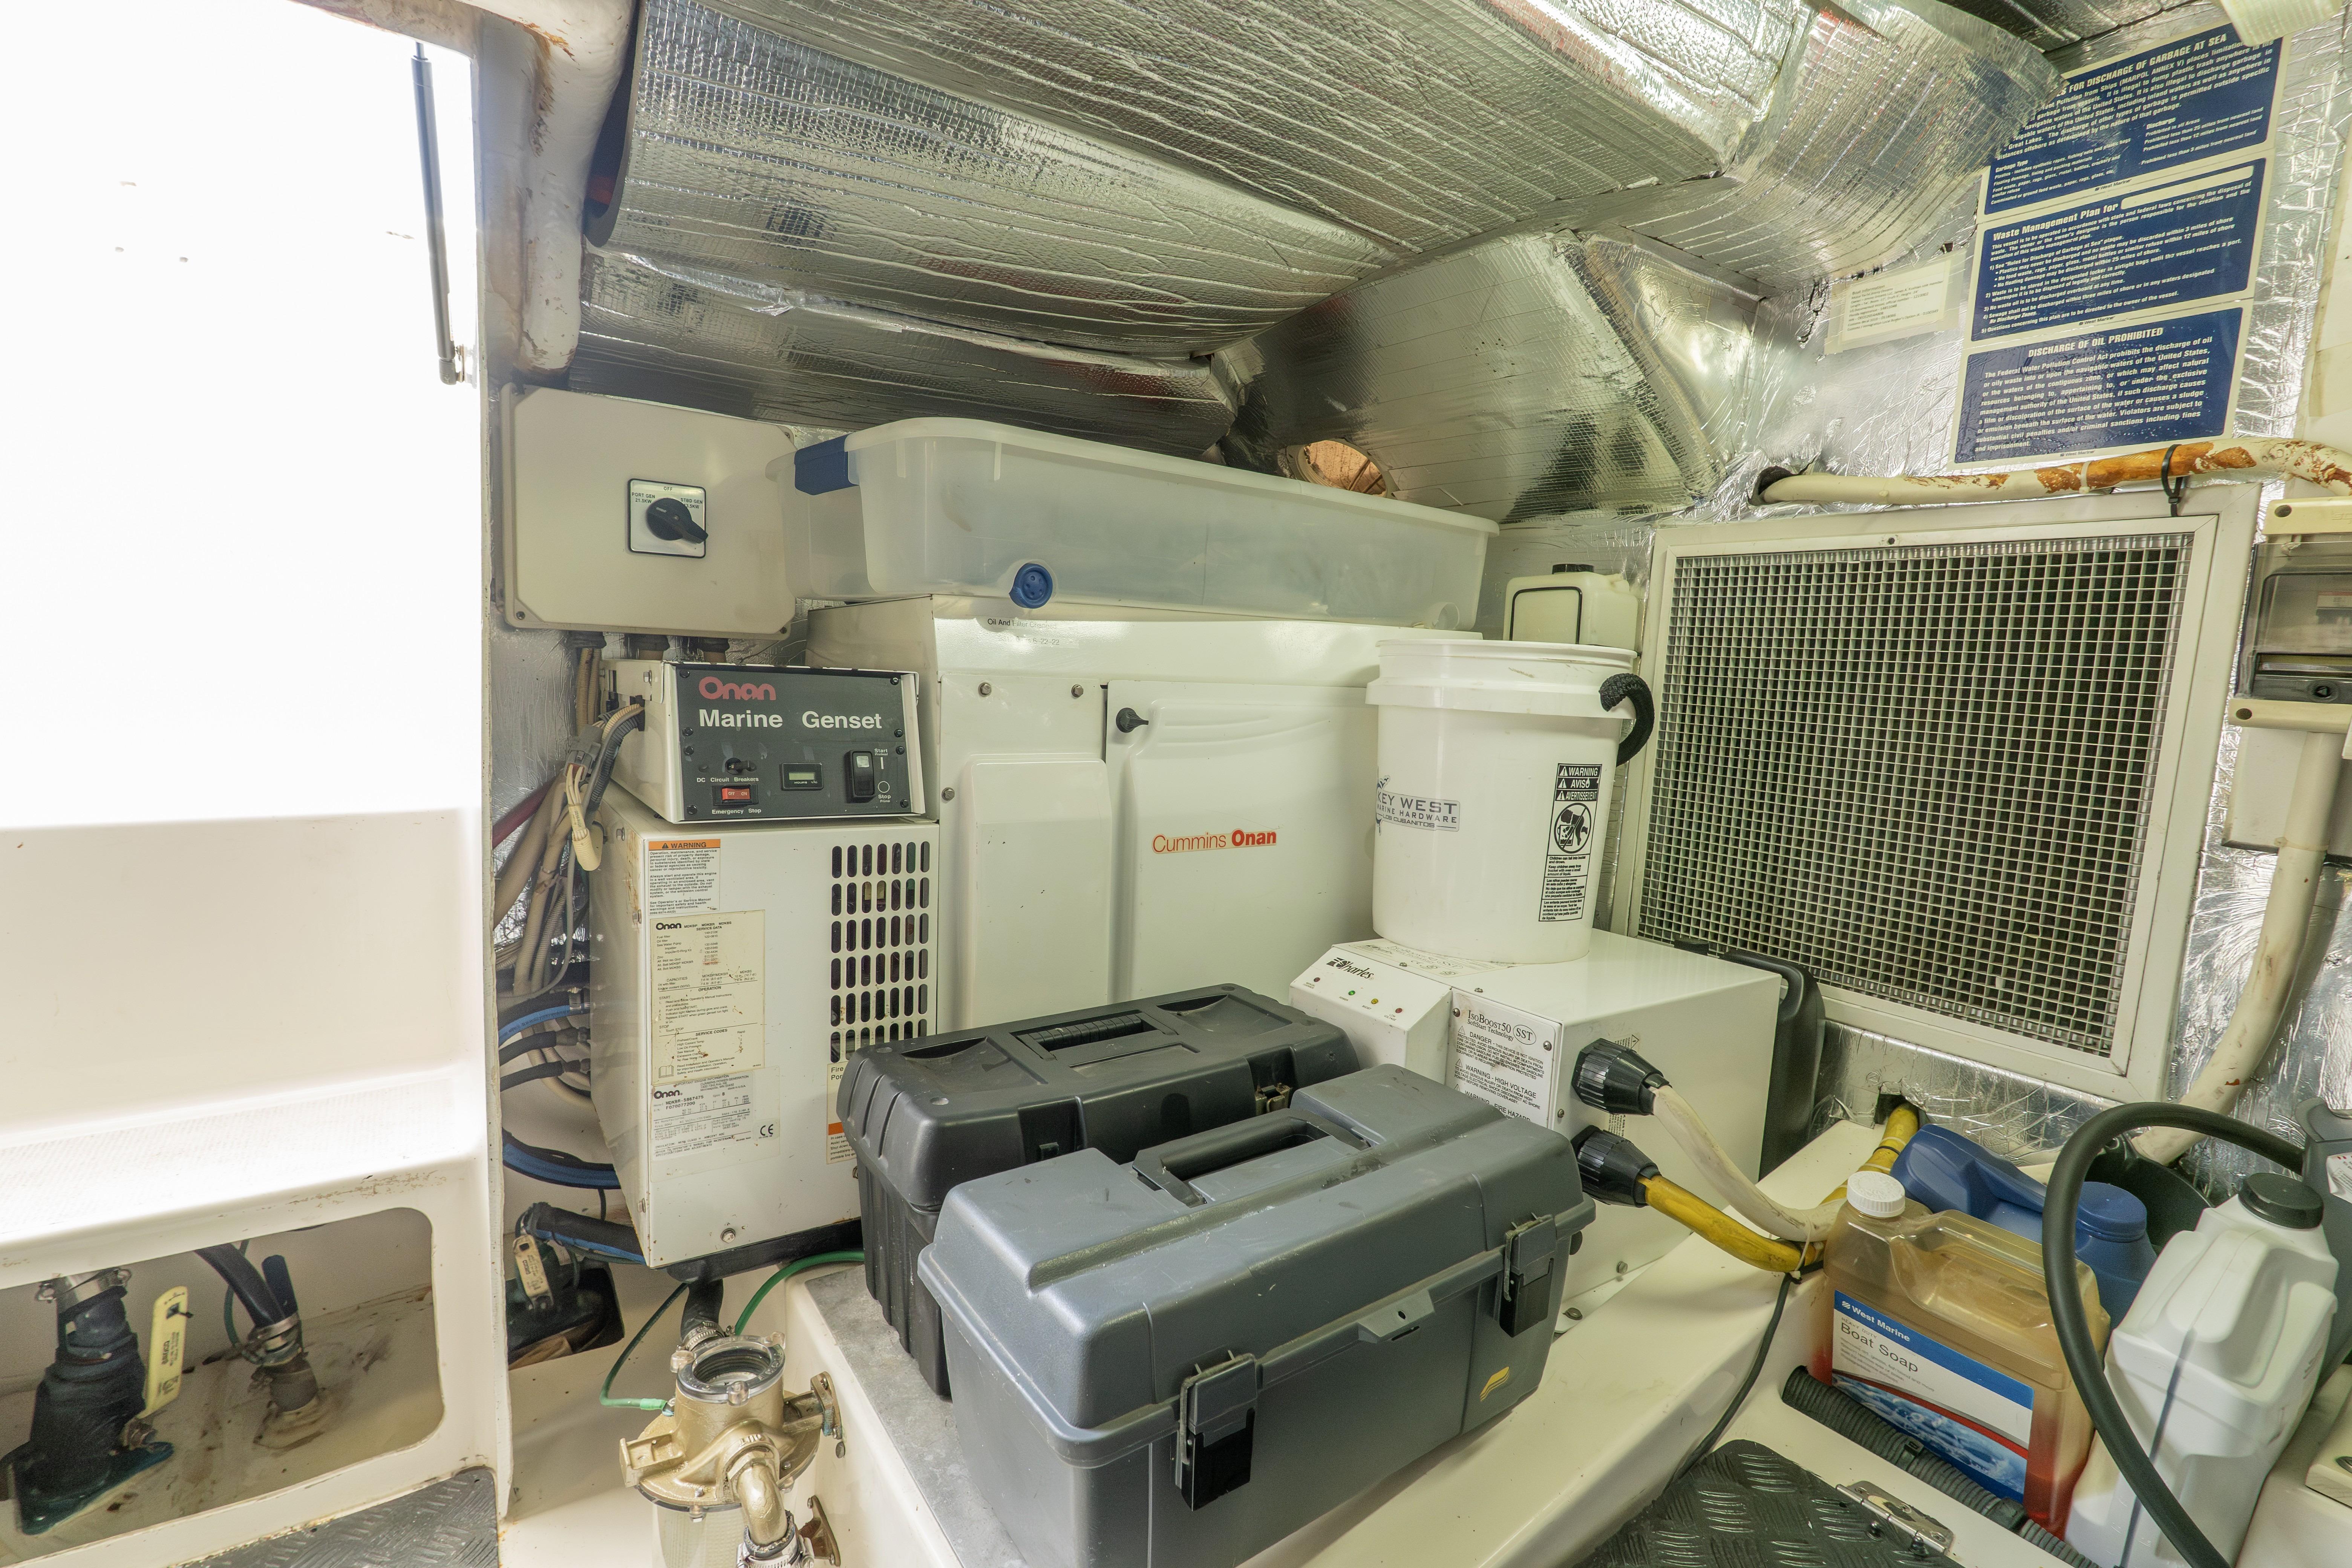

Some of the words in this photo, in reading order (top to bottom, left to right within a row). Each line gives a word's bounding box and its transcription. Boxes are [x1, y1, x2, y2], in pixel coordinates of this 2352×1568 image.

[2070, 82, 2084, 93] FOR
[2087, 66, 2134, 88] DISCHARGE
[2136, 59, 2147, 70] OF
[2150, 46, 2191, 66] GARBAGE
[2192, 41, 2205, 52] AT
[2208, 34, 2227, 47] SEA
[1994, 230, 2020, 241] Waste
[2022, 214, 2078, 234] Management
[2080, 209, 2100, 219] Plan
[2103, 204, 2118, 213] for
[2028, 342, 2075, 357] DISCHARGE
[2078, 340, 2089, 348] OF
[2092, 337, 2105, 346] OIL
[2108, 327, 2164, 344] PROHIBITED
[1997, 368, 2020, 376] Federal
[2072, 355, 2096, 364] Control
[2110, 349, 2140, 360] prohibits
[2155, 340, 2191, 351] discharge
[2076, 363, 2109, 374] navigable
[2110, 360, 2134, 368] waters
[2158, 351, 2182, 361] United
[2184, 348, 2210, 357] States,
[698, 676, 776, 701] Onan
[699, 709, 783, 728] Marine
[801, 710, 882, 729] Genset
[1569, 767, 1598, 776] WARNING
[1571, 779, 1590, 788] AVISO
[1377, 791, 1395, 805] KEY
[1400, 797, 1457, 814] WEST
[1377, 804, 1395, 814] MARINE
[1400, 810, 1456, 823] HARDWARE
[1393, 817, 1435, 828] CUBANITOS
[1152, 832, 1227, 853] Cummins
[1231, 829, 1277, 847] Onan
[1467, 1019, 1486, 1030] SoftStart
[1488, 1026, 1514, 1041] Technology
[1516, 1028, 1533, 1041] SST
[1470, 1032, 1491, 1044] DANGER
[1528, 1056, 1544, 1064] IGNITION
[1466, 1064, 1490, 1079] WARNING
[1495, 1076, 1508, 1087] HIGH
[1510, 1083, 1536, 1098] VOLTAGE
[654, 1090, 680, 1099] Onan
[666, 1101, 695, 1110] F070077200
[1494, 1104, 1506, 1113] FIRE
[1851, 1305, 1875, 1323] West
[1877, 1319, 1910, 1341] Marine
[1841, 1322, 1874, 1348] Boat
[1879, 1344, 1918, 1372] Soap
